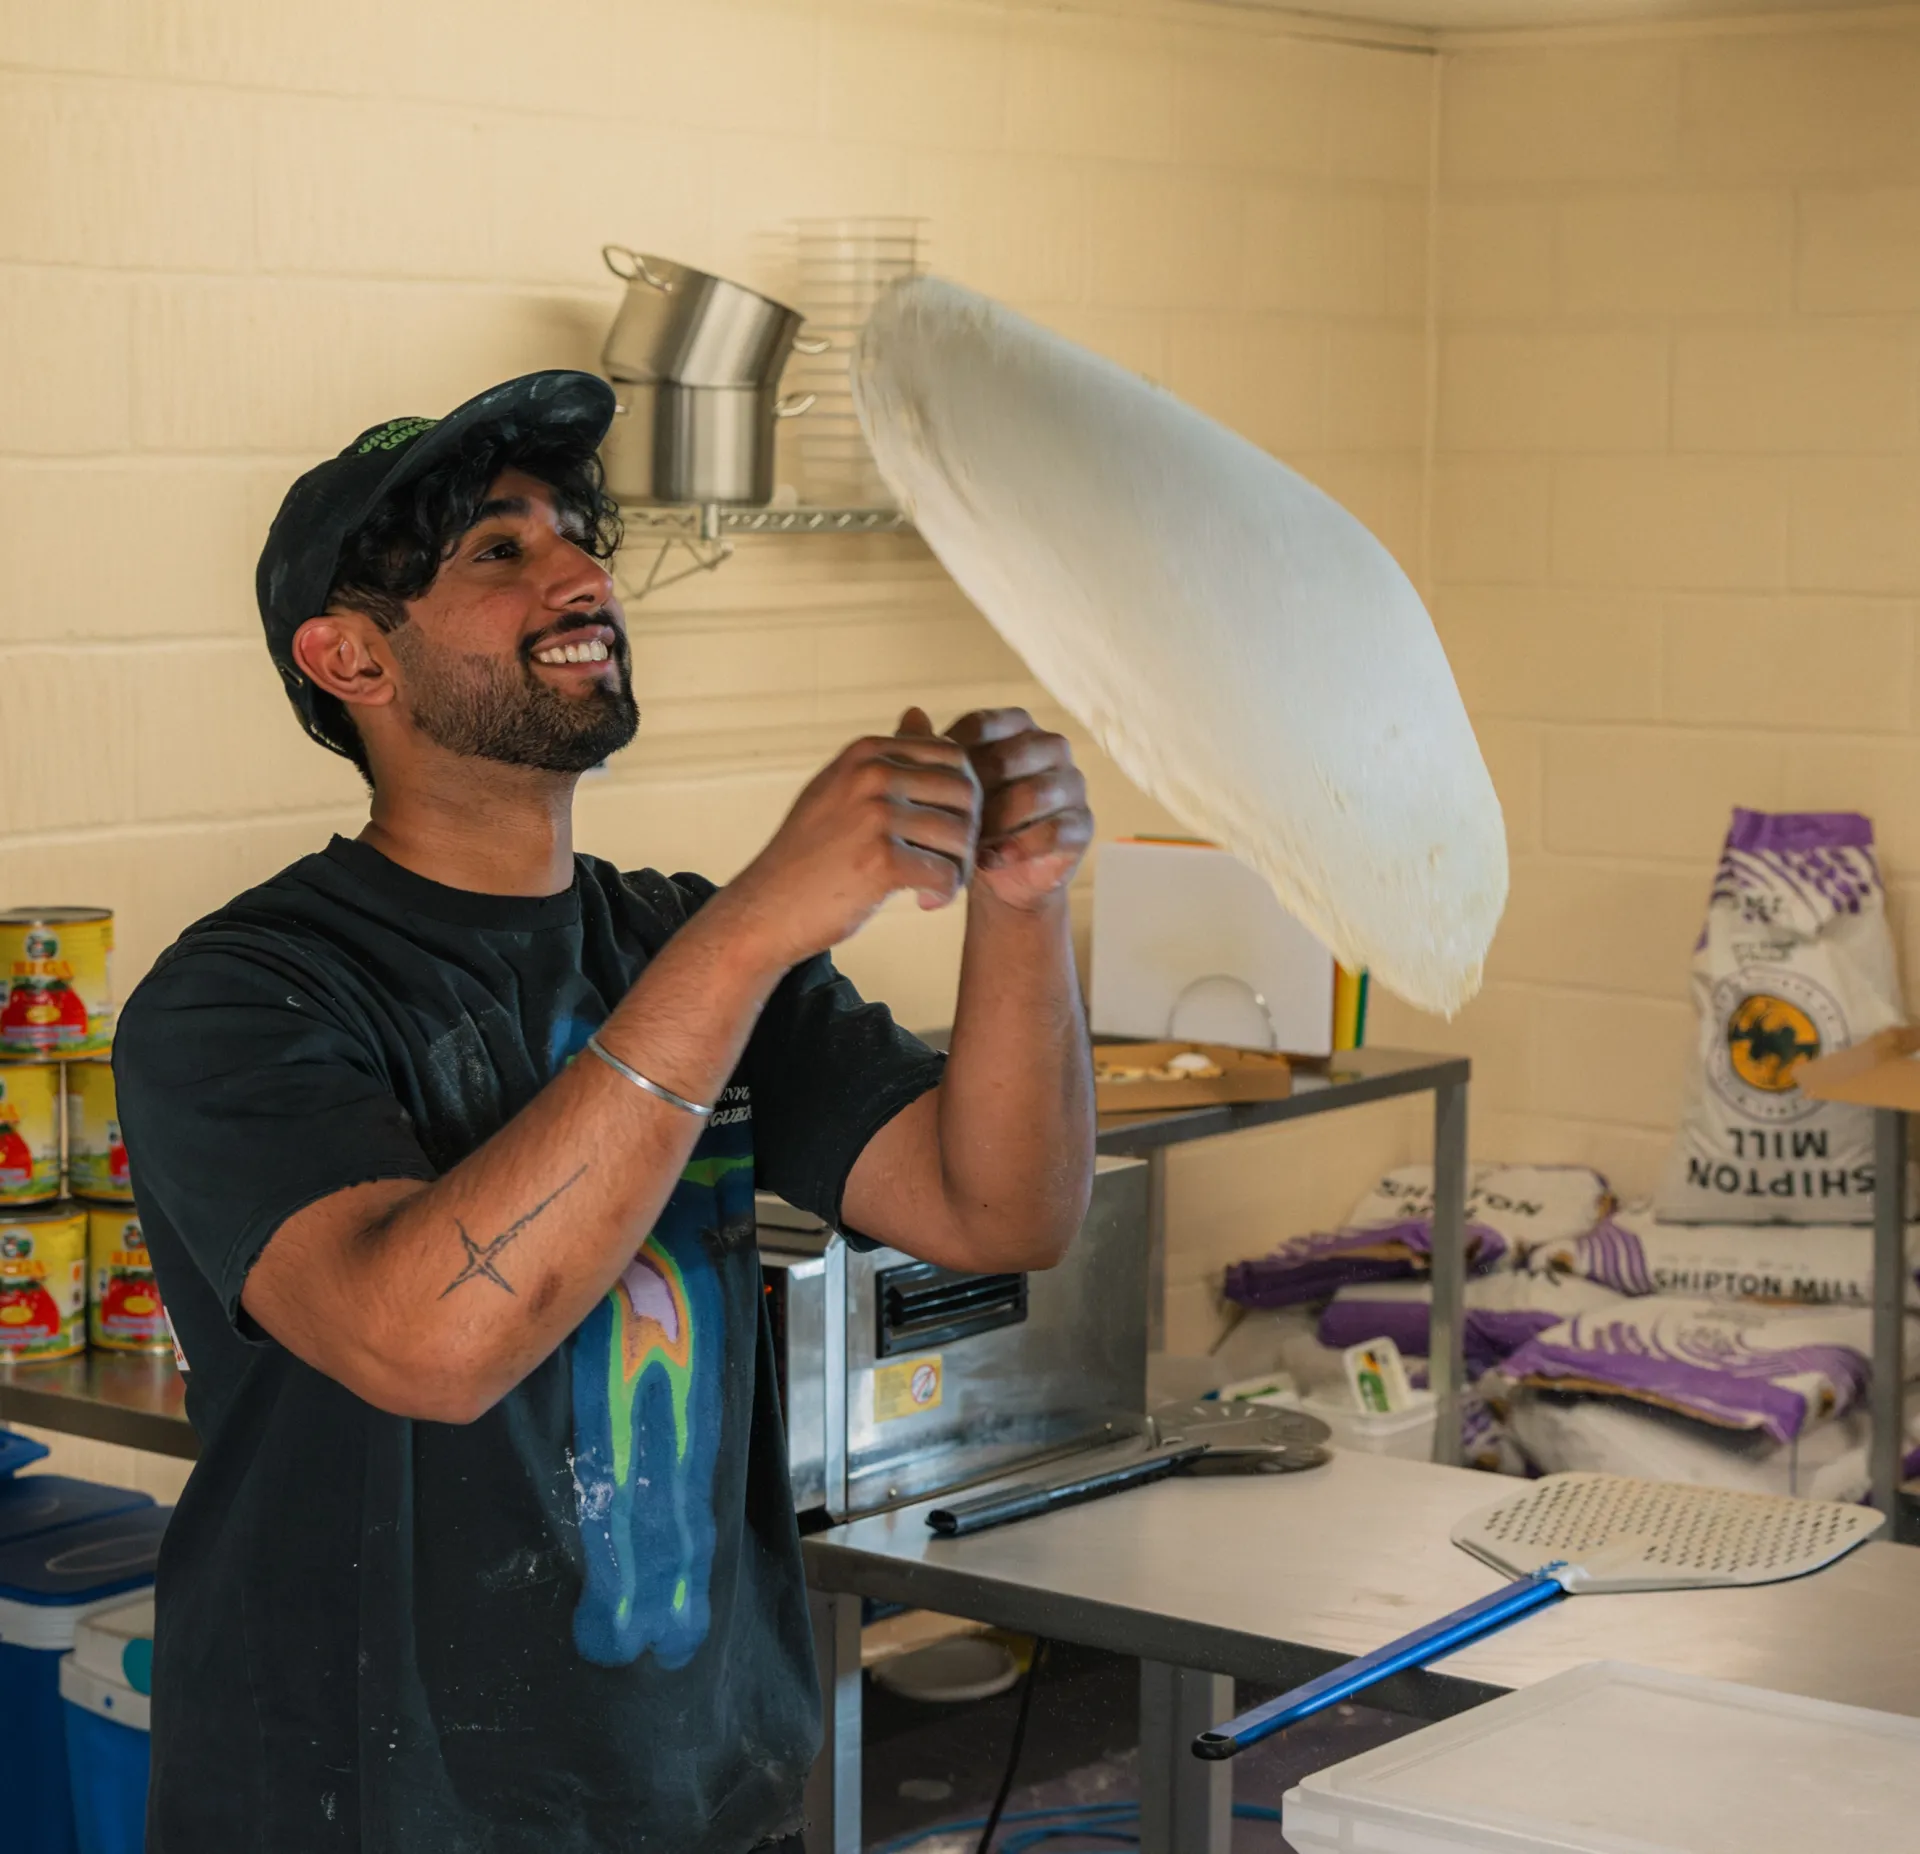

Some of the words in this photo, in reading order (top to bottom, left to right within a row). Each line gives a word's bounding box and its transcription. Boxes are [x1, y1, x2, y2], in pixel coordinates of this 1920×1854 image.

[1727, 1127, 1828, 1159] MILL
[1687, 1157, 1876, 1197] SHIPTON
[1654, 1268, 1782, 1297] SHIPTON
[1793, 1277, 1866, 1304] MILL
